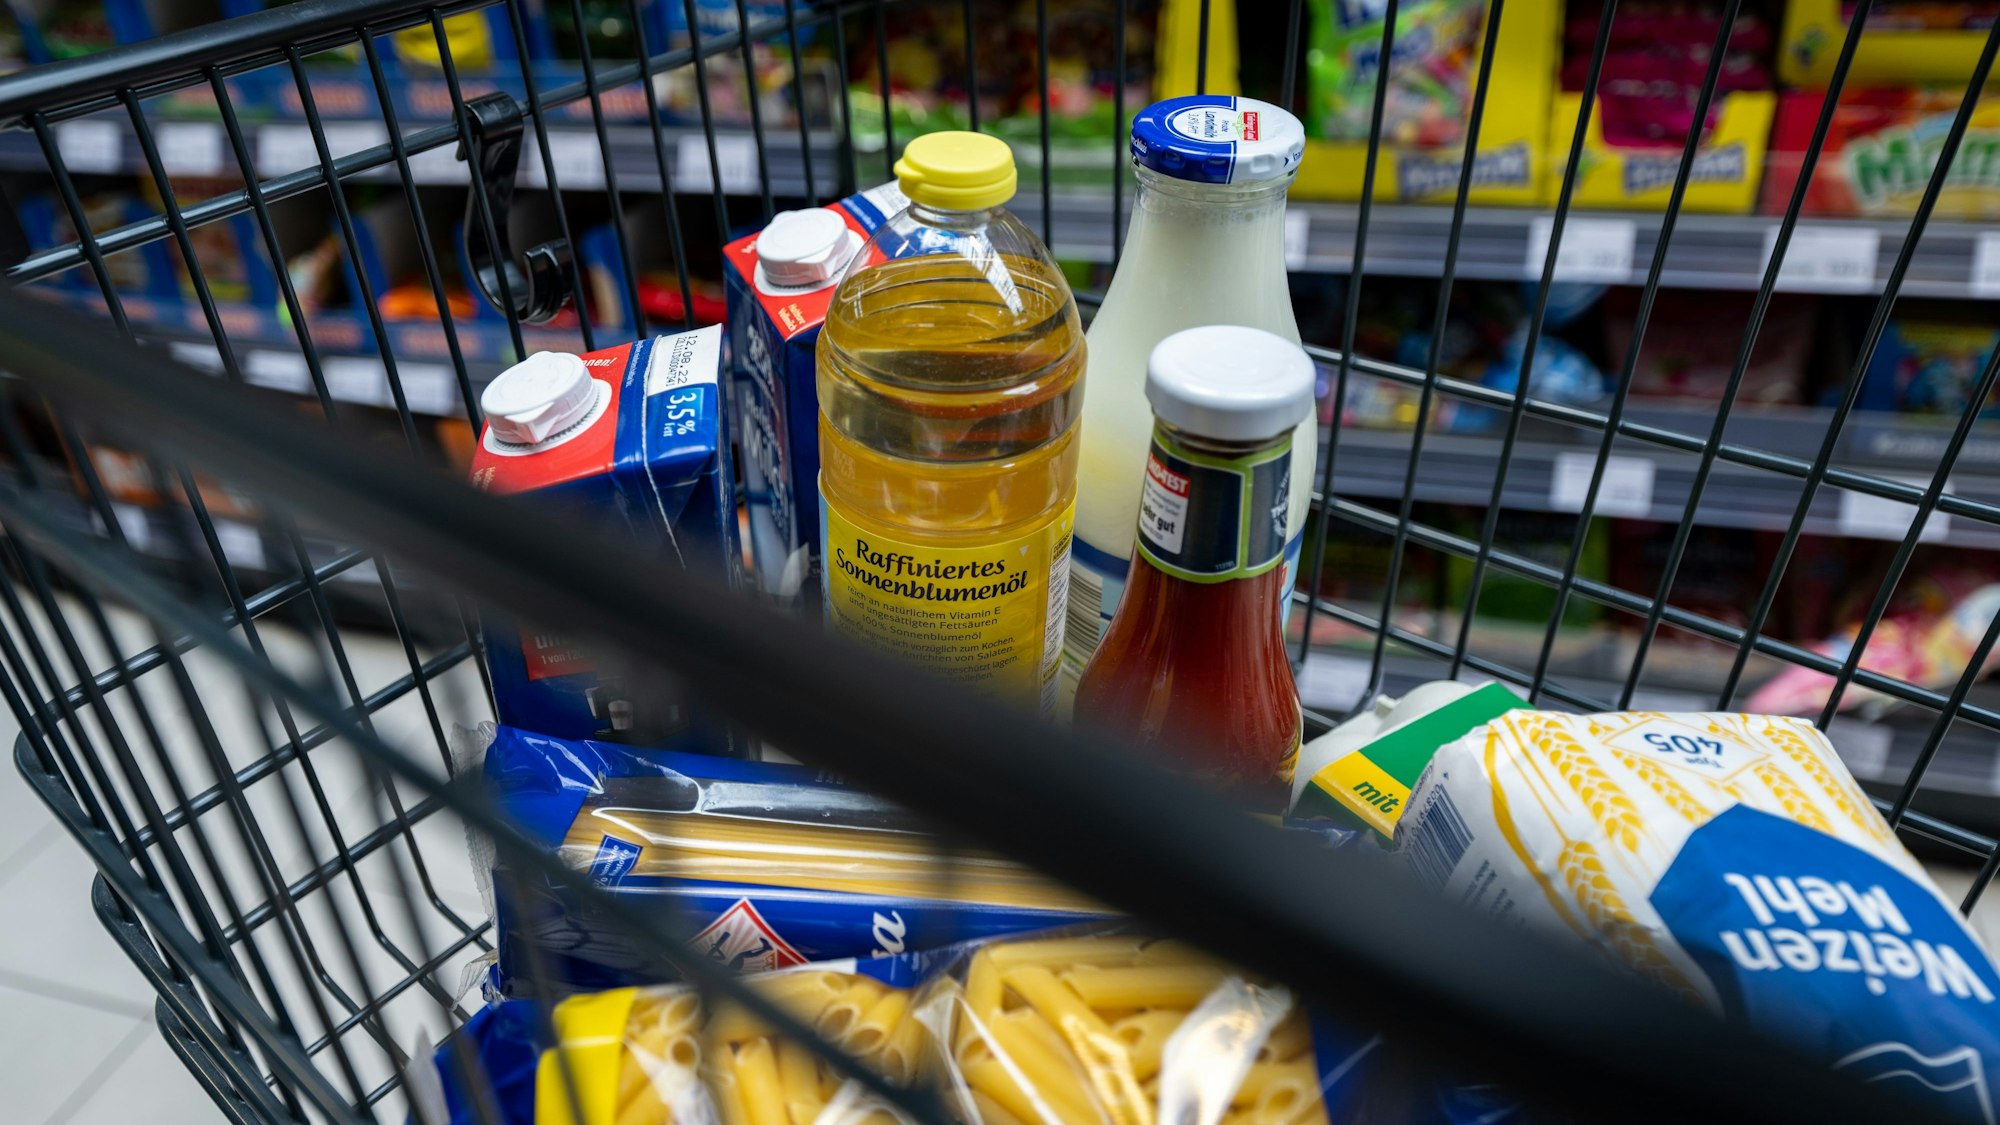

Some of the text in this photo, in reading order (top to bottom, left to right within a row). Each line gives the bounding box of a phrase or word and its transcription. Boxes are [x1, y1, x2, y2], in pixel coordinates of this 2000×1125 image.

[677, 335, 698, 385] 12.08.22
[666, 392, 697, 436] 3,5%
[1158, 516, 1176, 535] gut
[836, 548, 1028, 602] Sonnenblumenöl
[856, 539, 1006, 580] Raffiniertes
[847, 585, 1001, 620] reich an natürlichem Vitamin E
[849, 596, 998, 630] und ungesättigten Fettsäuren
[890, 625, 982, 641] Sonnenblumenöl
[891, 636, 909, 648] sich
[910, 641, 957, 656] vorzüglich
[960, 643, 979, 651] zum
[981, 635, 1016, 650] Kochen,
[549, 652, 566, 664] von
[955, 653, 974, 662] von
[1644, 733, 1724, 755] 405
[1352, 781, 1400, 814] mit
[1723, 872, 1912, 935] Mehl
[1719, 927, 1996, 1003] Weizen
